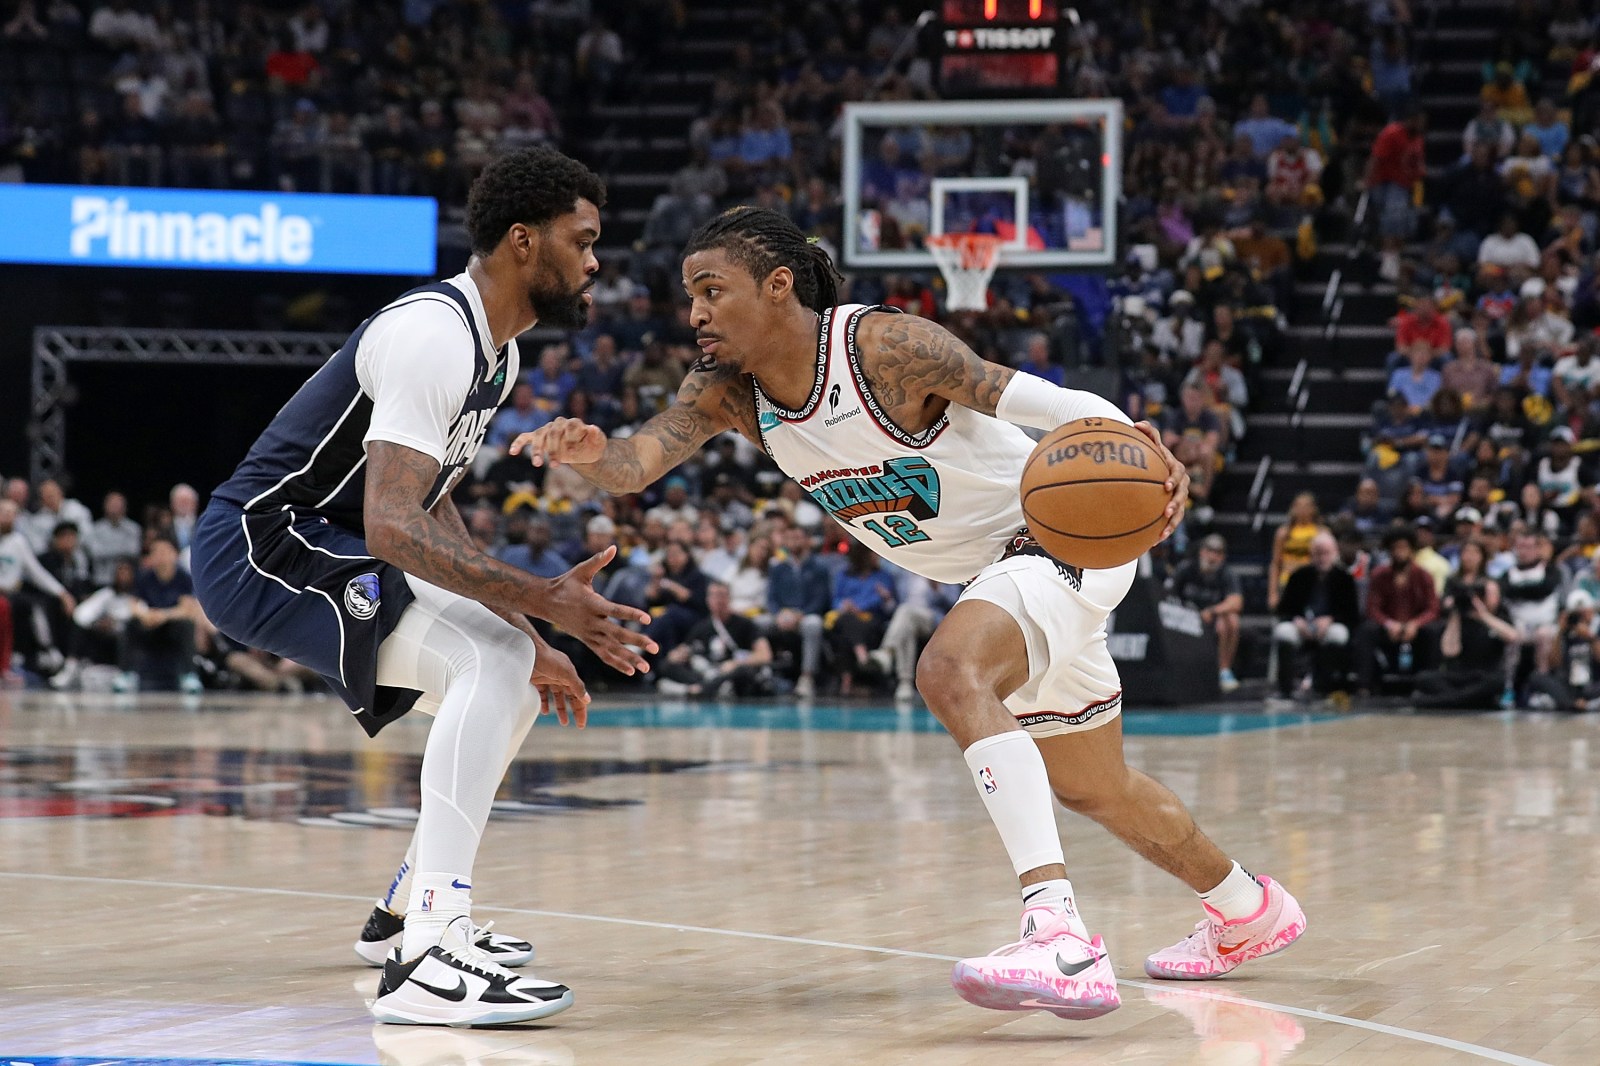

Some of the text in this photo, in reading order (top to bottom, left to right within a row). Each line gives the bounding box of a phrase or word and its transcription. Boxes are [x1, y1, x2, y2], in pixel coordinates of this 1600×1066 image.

[974, 27, 1056, 49] TISSOT
[70, 196, 314, 265] Pinnacle
[824, 406, 863, 429] Robinhood
[1046, 440, 1149, 470] Wilson
[800, 465, 883, 488] VANCOUVER
[808, 456, 941, 521] RIZZLIES
[863, 515, 932, 549] 12
